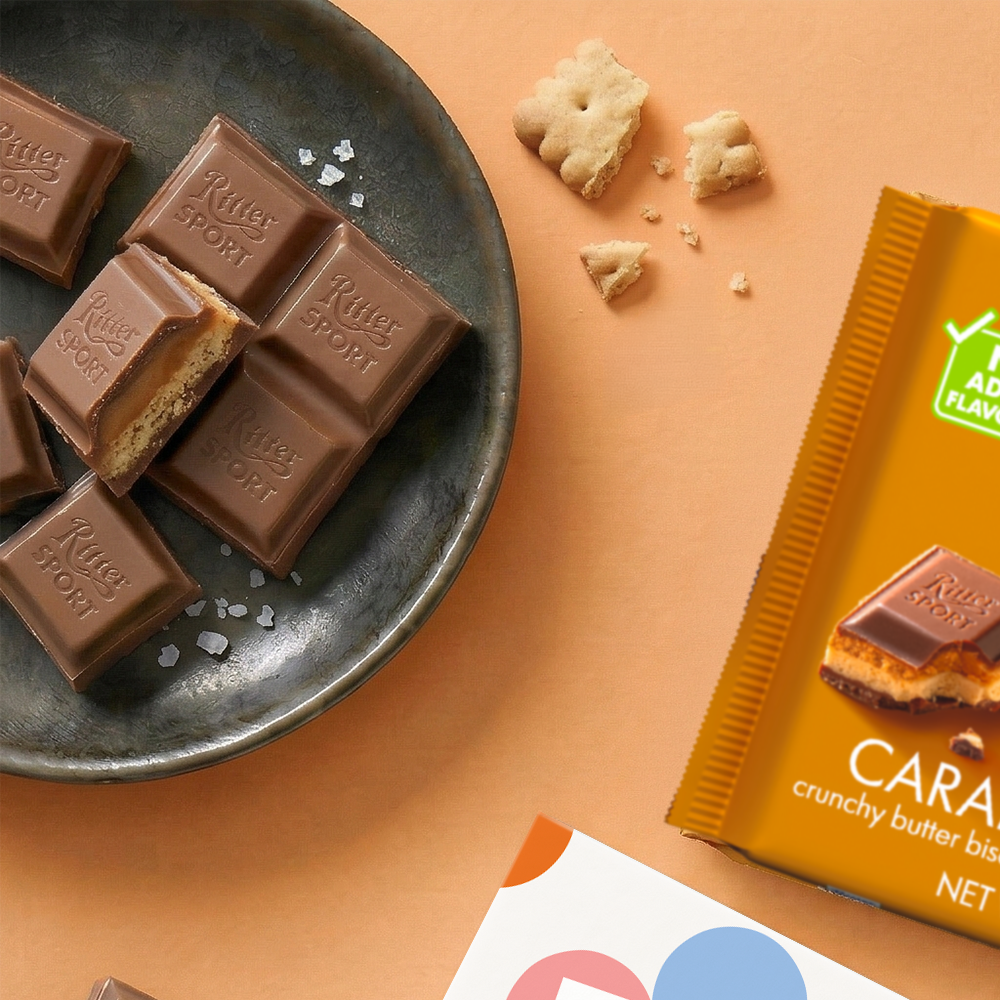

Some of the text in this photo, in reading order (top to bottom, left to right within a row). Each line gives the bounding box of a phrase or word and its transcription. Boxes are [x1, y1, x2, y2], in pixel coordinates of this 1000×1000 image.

[0, 175, 51, 212] ORT
[189, 170, 279, 243] Ritter
[174, 204, 254, 268] SPORT
[73, 290, 141, 358] Ritter
[299, 307, 379, 374] SPORT
[316, 273, 403, 351] Ritter
[56, 328, 110, 386] SPORT
[201, 437, 278, 503] SPORT
[216, 403, 303, 479] Ritter
[31, 544, 99, 620] SPORT
[51, 517, 132, 603] Ritter
[904, 589, 977, 630] SPORT
[921, 571, 1000, 618] Ritter
[792, 780, 887, 829] crunchy
[890, 804, 962, 848] butter
[936, 871, 996, 912] NET
